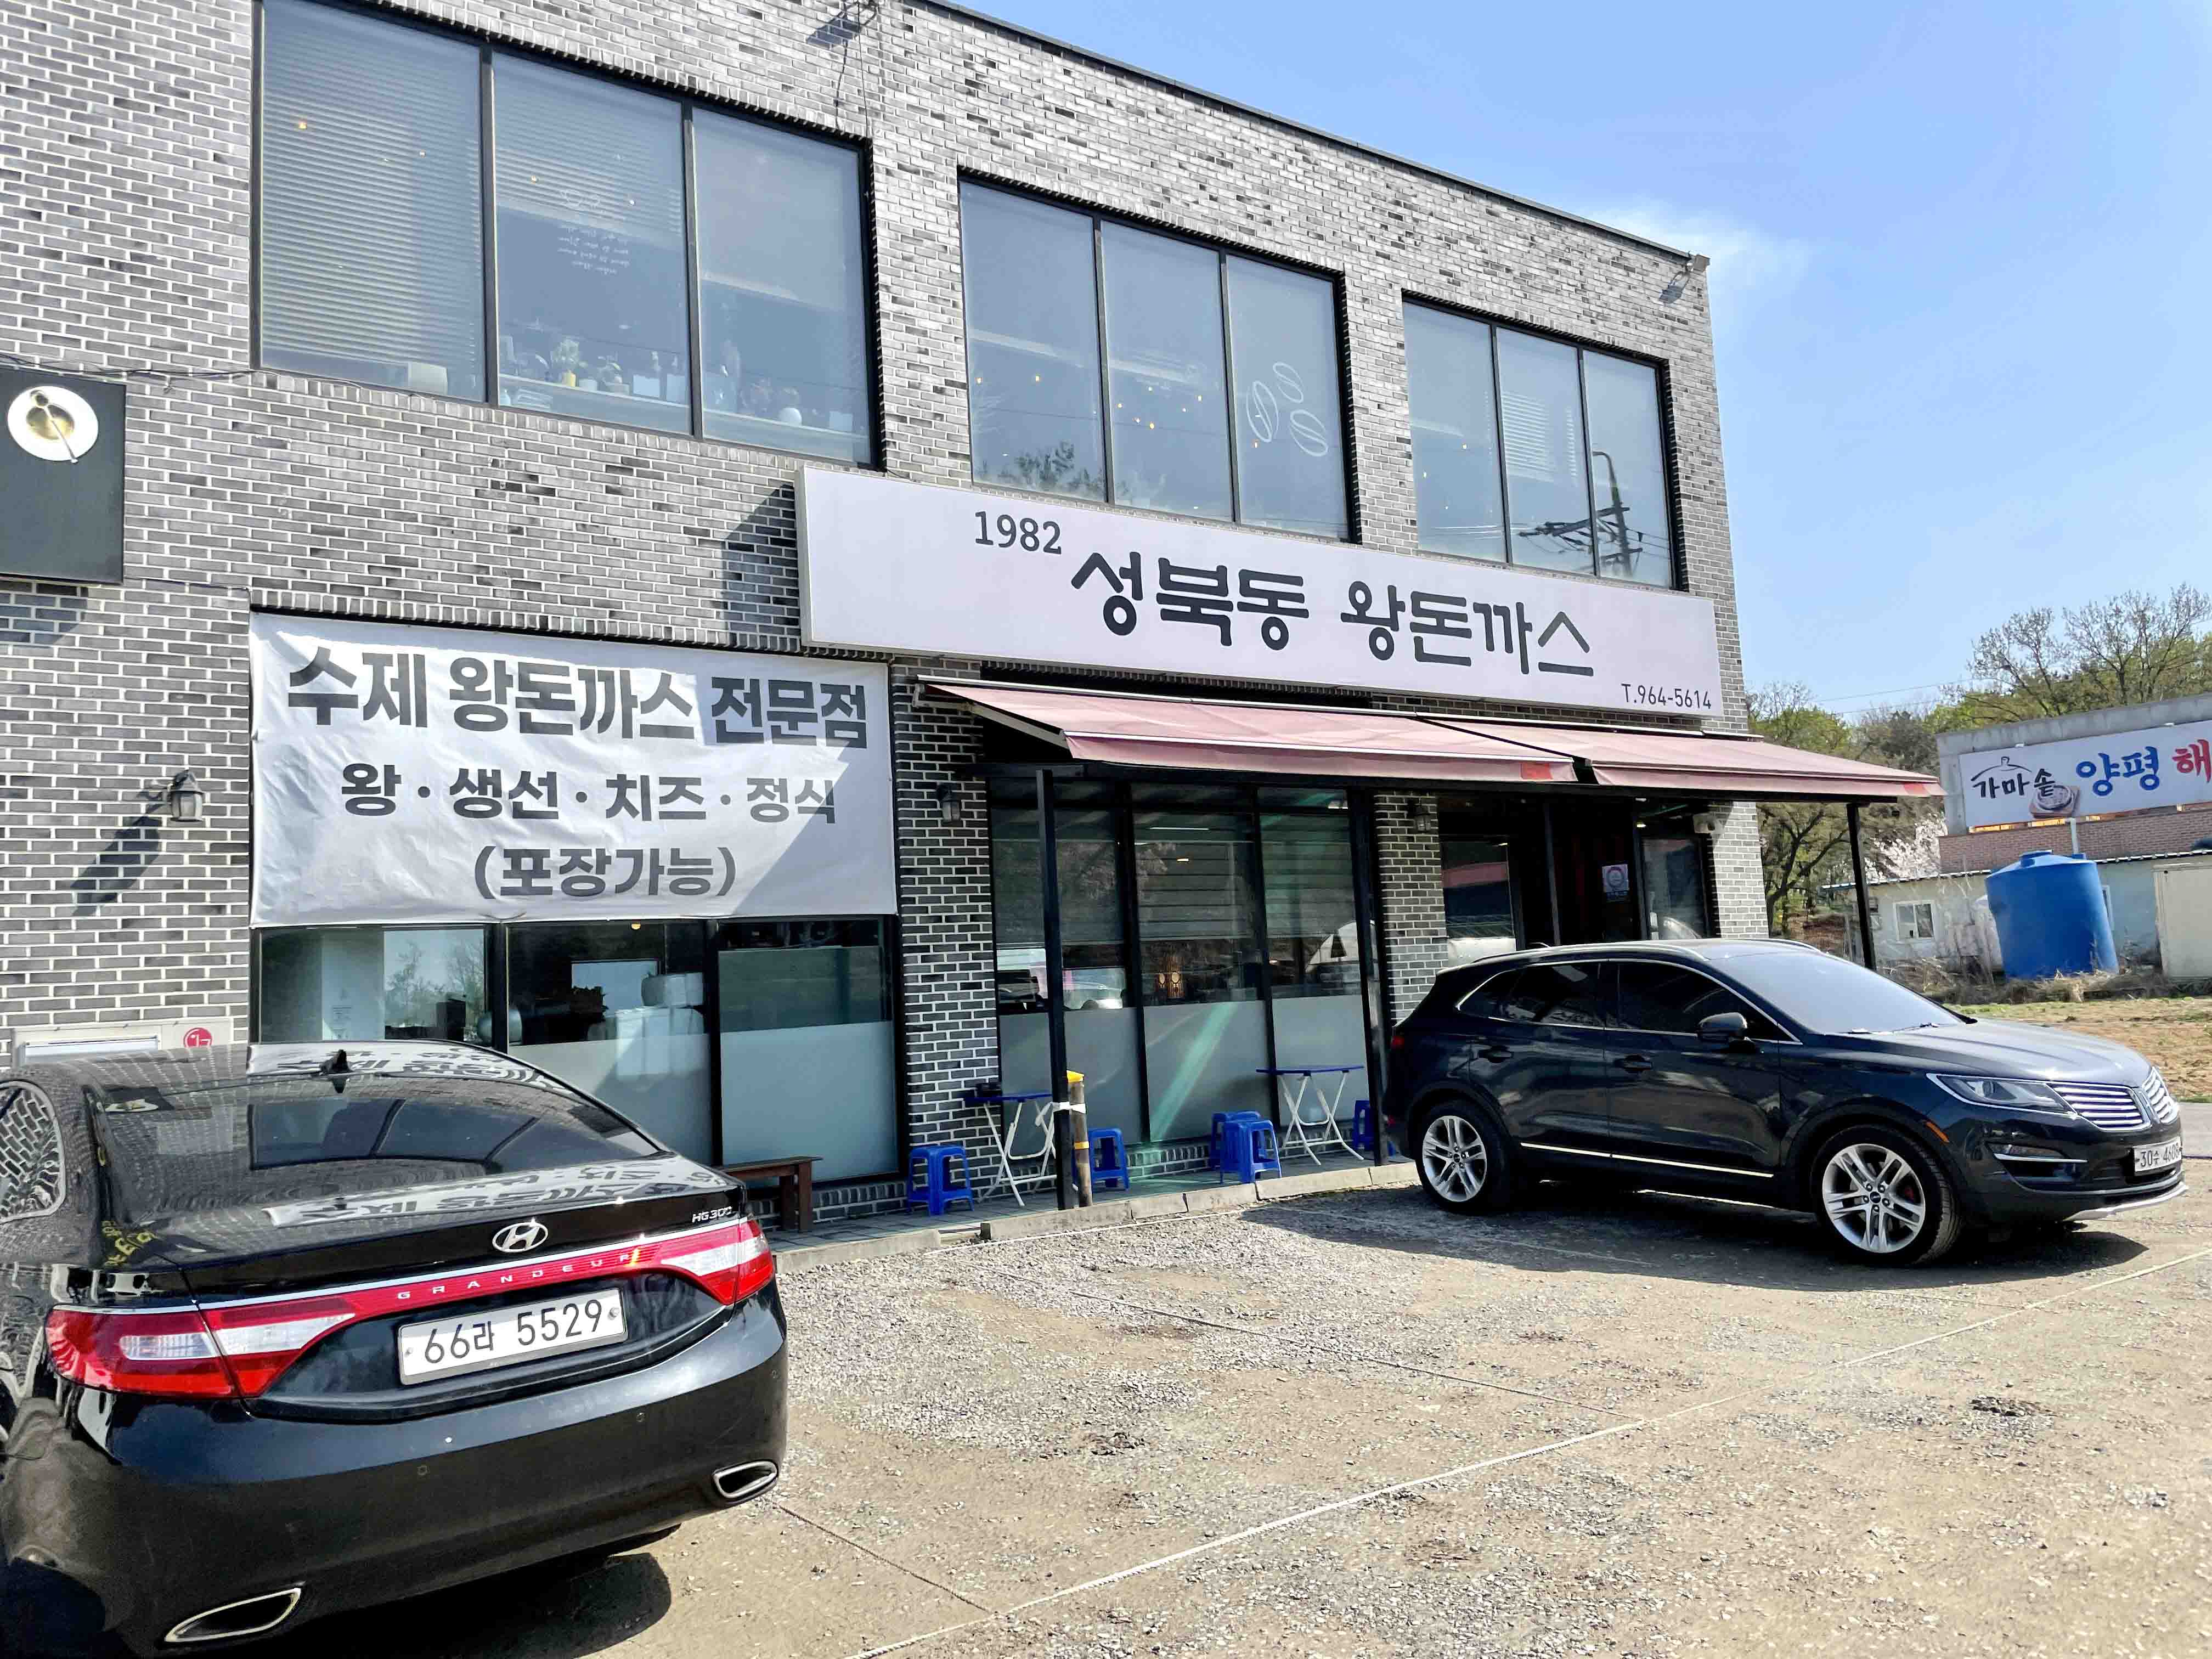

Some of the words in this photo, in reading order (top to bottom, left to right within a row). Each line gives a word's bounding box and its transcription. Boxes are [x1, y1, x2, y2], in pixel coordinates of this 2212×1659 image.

[974, 510, 1062, 555] 1982
[1070, 551, 1310, 651] 성북동
[1340, 579, 1596, 678] 왕돈까스
[287, 646, 428, 729] 수제
[449, 656, 695, 740] 왕돈까스
[710, 675, 868, 749] 전문점
[1621, 682, 1712, 710] T.964-5614
[341, 762, 403, 817] 왕
[449, 767, 559, 821] 생선
[605, 772, 707, 822] 치즈
[746, 777, 836, 825] 정식
[1972, 768, 2056, 799] 가마솥
[2075, 745, 2160, 797] 양평
[2172, 738, 2211, 783] 해
[473, 845, 737, 900] (포장가능)
[397, 1253, 629, 1300] GRANDEUR
[424, 1321, 495, 1363] 66라
[517, 1299, 603, 1346] 5529
